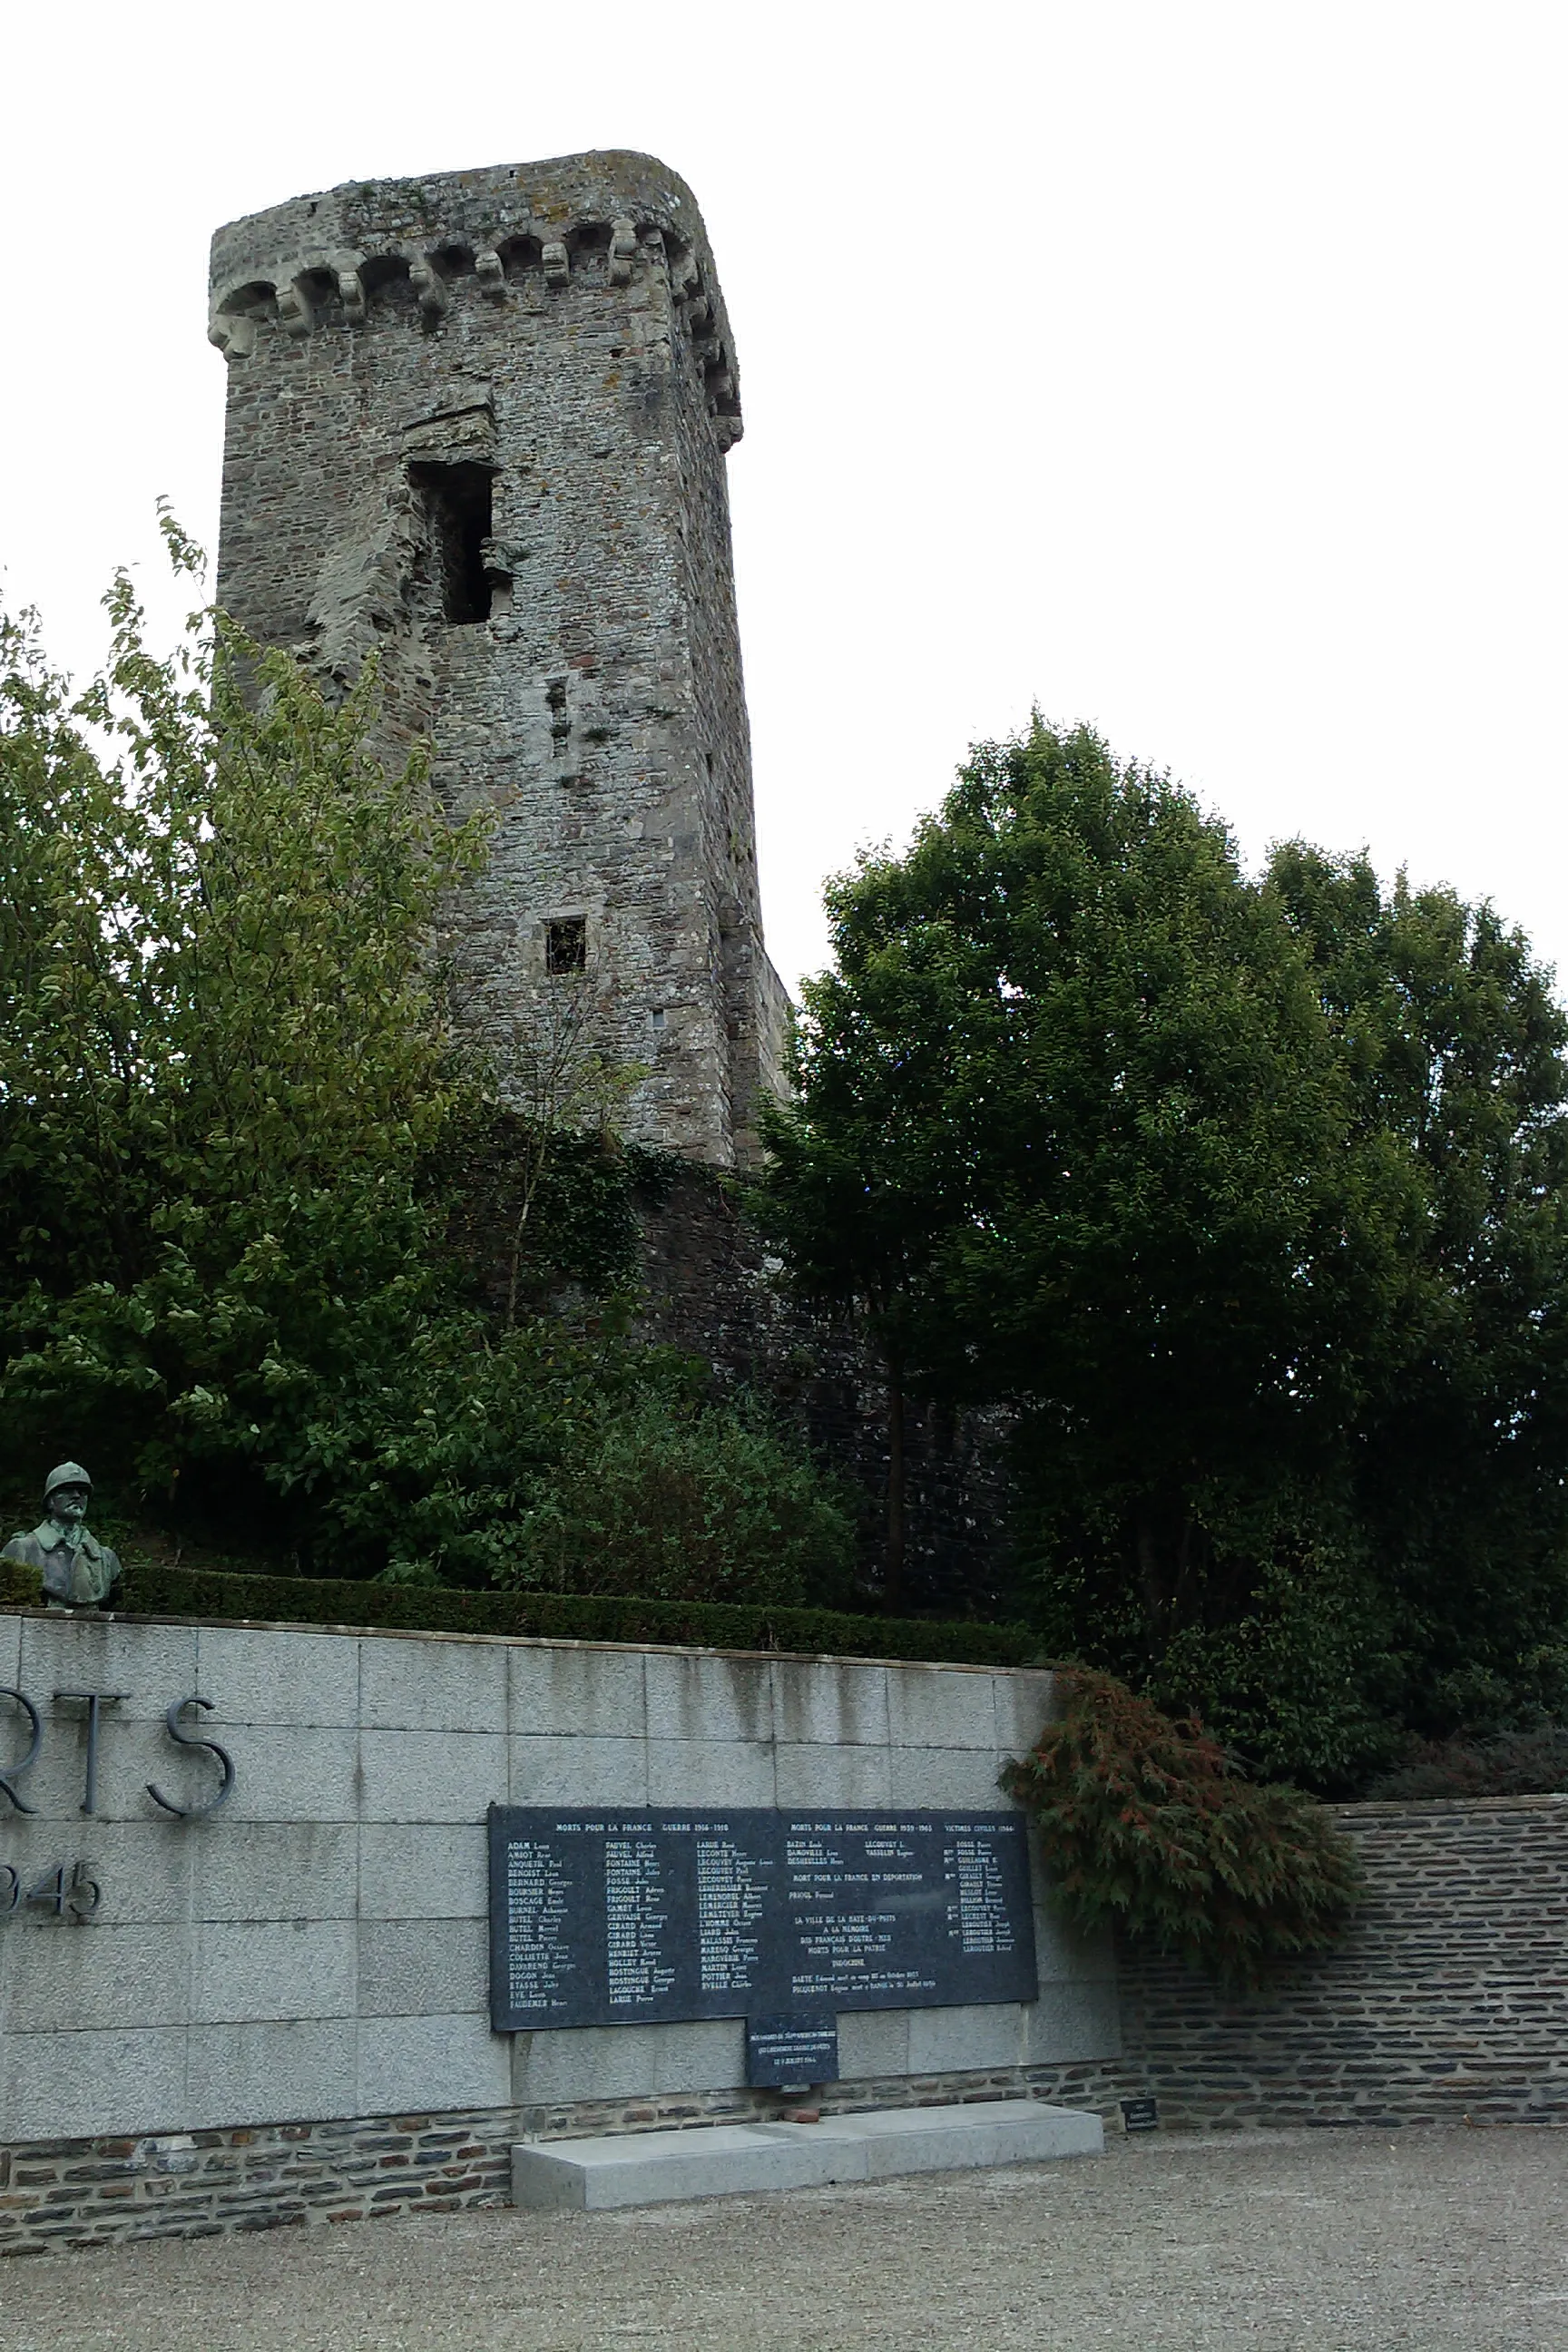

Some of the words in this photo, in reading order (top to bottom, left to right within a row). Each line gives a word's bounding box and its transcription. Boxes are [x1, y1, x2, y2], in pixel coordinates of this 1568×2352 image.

[790, 1823, 811, 1831] MORTS
[815, 1823, 831, 1831] POUR
[835, 1823, 843, 1831] LA
[846, 1823, 868, 1831] FRANCE
[874, 1823, 897, 1831] GUERRE
[945, 1824, 971, 1832] VICTIMES
[974, 1824, 995, 1832] CIVILES
[508, 1860, 544, 1868] ANQUETIL
[508, 1869, 541, 1877] BENOIST
[508, 1878, 544, 1886] BERNARD
[508, 1897, 544, 1906] BOSCAGE
[826, 1916, 835, 1924] DE
[701, 1936, 732, 1945] MALASSIS
[800, 1936, 812, 1945] DES
[815, 1936, 846, 1945] FRANÇAIS
